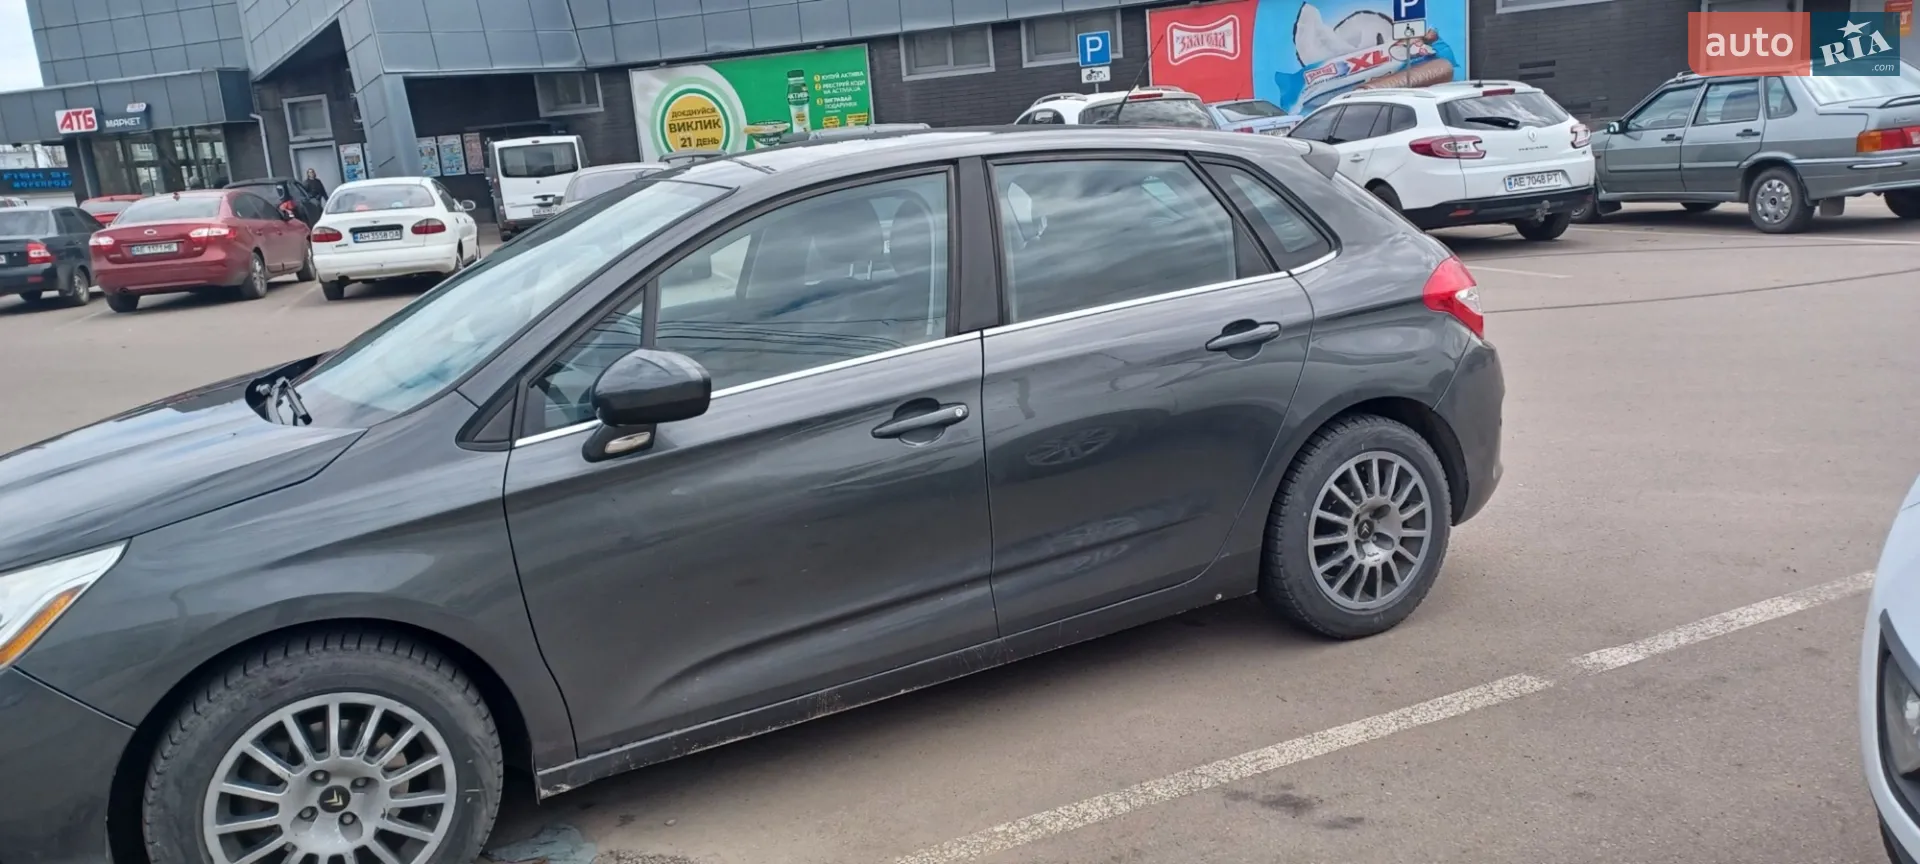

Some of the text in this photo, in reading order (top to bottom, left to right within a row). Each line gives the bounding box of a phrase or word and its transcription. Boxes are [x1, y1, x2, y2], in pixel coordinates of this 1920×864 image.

[1401, 0, 1419, 18] P
[1086, 36, 1102, 62] P
[1346, 50, 1390, 73] XL
[60, 109, 95, 130] АТБ
[105, 116, 141, 128] МАРКЕТ
[668, 118, 722, 133] ВИКЛИК
[680, 136, 719, 147] 21 ДЕНЬ
[1514, 176, 1525, 187] AE
[1526, 174, 1546, 186] 7048
